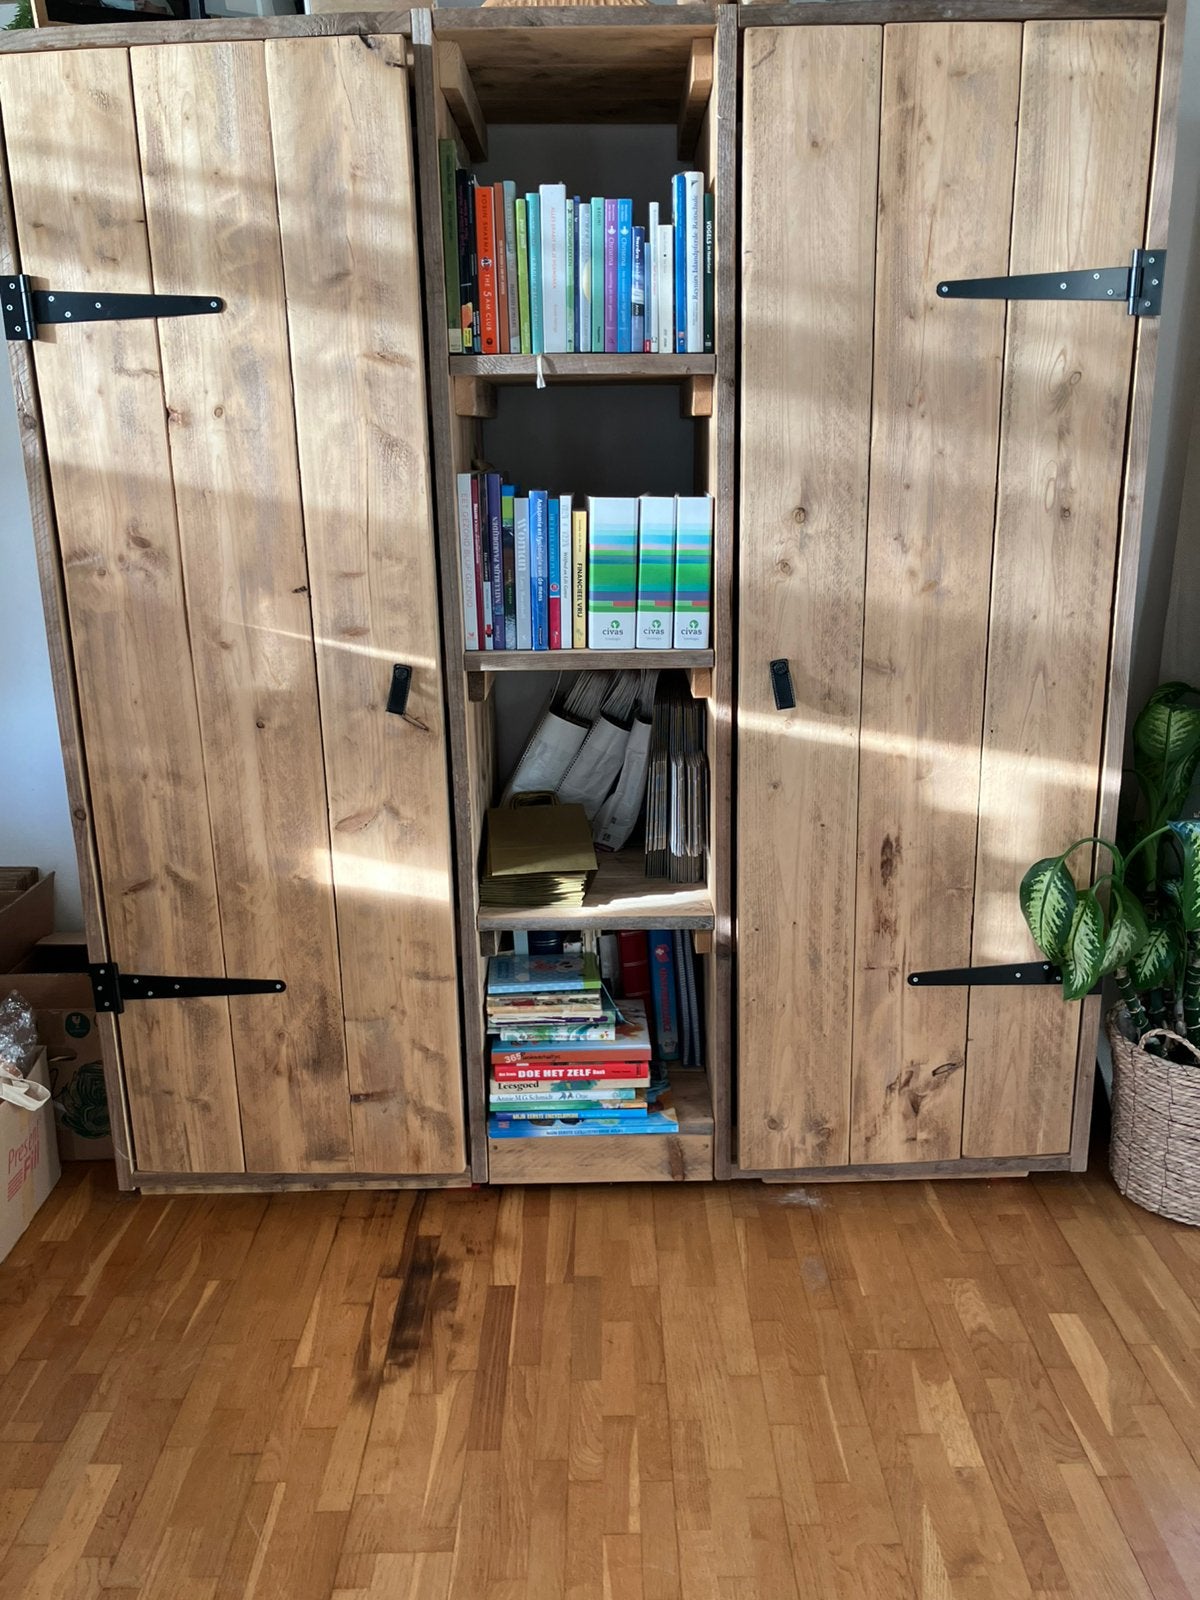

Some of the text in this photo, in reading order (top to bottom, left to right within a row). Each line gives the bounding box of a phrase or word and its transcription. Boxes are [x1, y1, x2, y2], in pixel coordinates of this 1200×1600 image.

[482, 222, 490, 253] SHARMA
[608, 237, 616, 266] Christina
[620, 237, 628, 267] Christina
[482, 290, 492, 298] 5
[485, 298, 491, 311] AM
[485, 312, 493, 332] CLUB
[462, 511, 470, 547] GEZOND
[517, 518, 527, 572] Woman
[492, 516, 502, 604] NATUURLIJK PAARDRIJDEN
[465, 573, 474, 608] GEZOND
[602, 628, 624, 636] civas
[643, 627, 665, 635] civas
[680, 627, 703, 636] civas
[504, 1052, 522, 1064] 365
[518, 1069, 541, 1079] DOE
[543, 1069, 565, 1078] HET
[567, 1068, 591, 1077] ZELF
[497, 1081, 540, 1093] Leesgoed
[496, 1094, 516, 1103] Annie
[528, 1093, 554, 1102] Schmidt
[8, 1119, 40, 1175] Present
[23, 1140, 40, 1181] Fill
